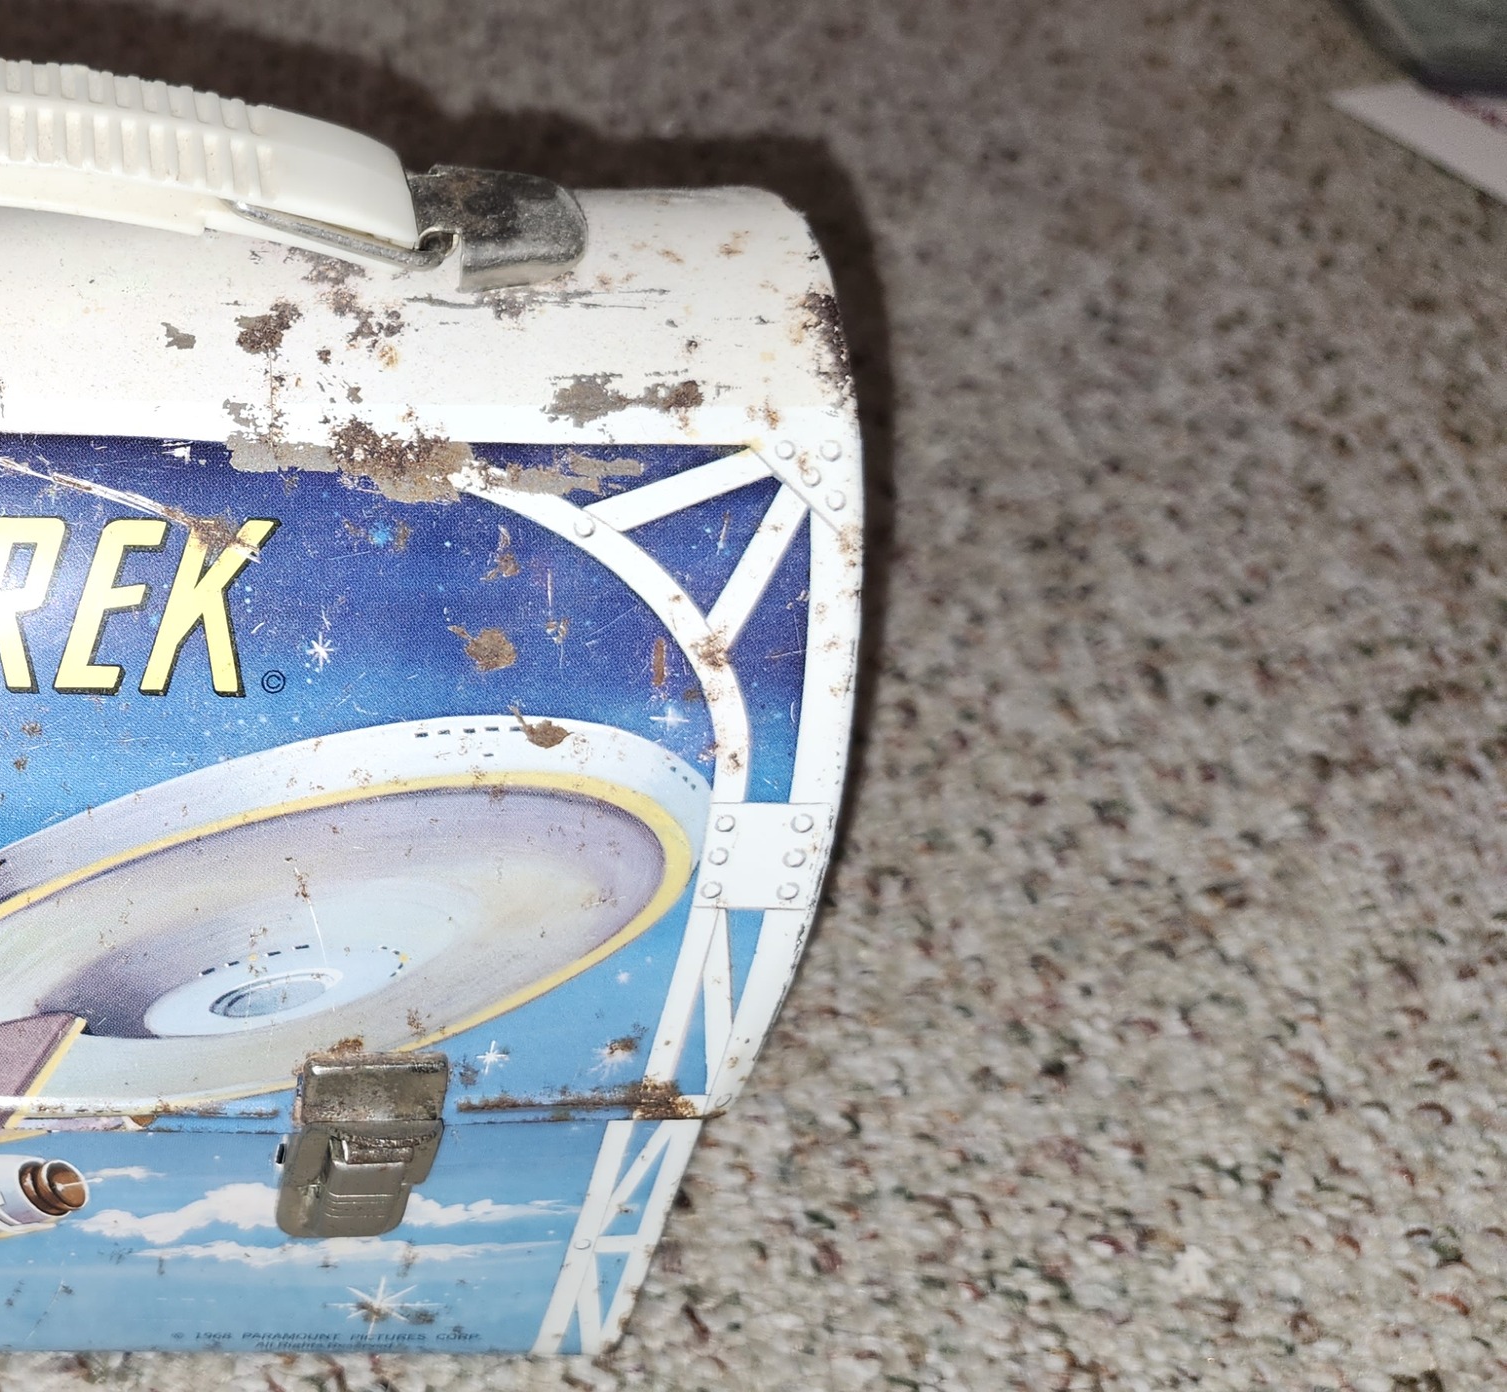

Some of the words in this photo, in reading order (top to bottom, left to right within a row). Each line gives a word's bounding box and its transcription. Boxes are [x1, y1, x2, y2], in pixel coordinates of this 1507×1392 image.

[195, 1331, 233, 1340] 1968
[241, 1331, 341, 1342] PARAMOUNT
[350, 1332, 427, 1342] PICTURES
